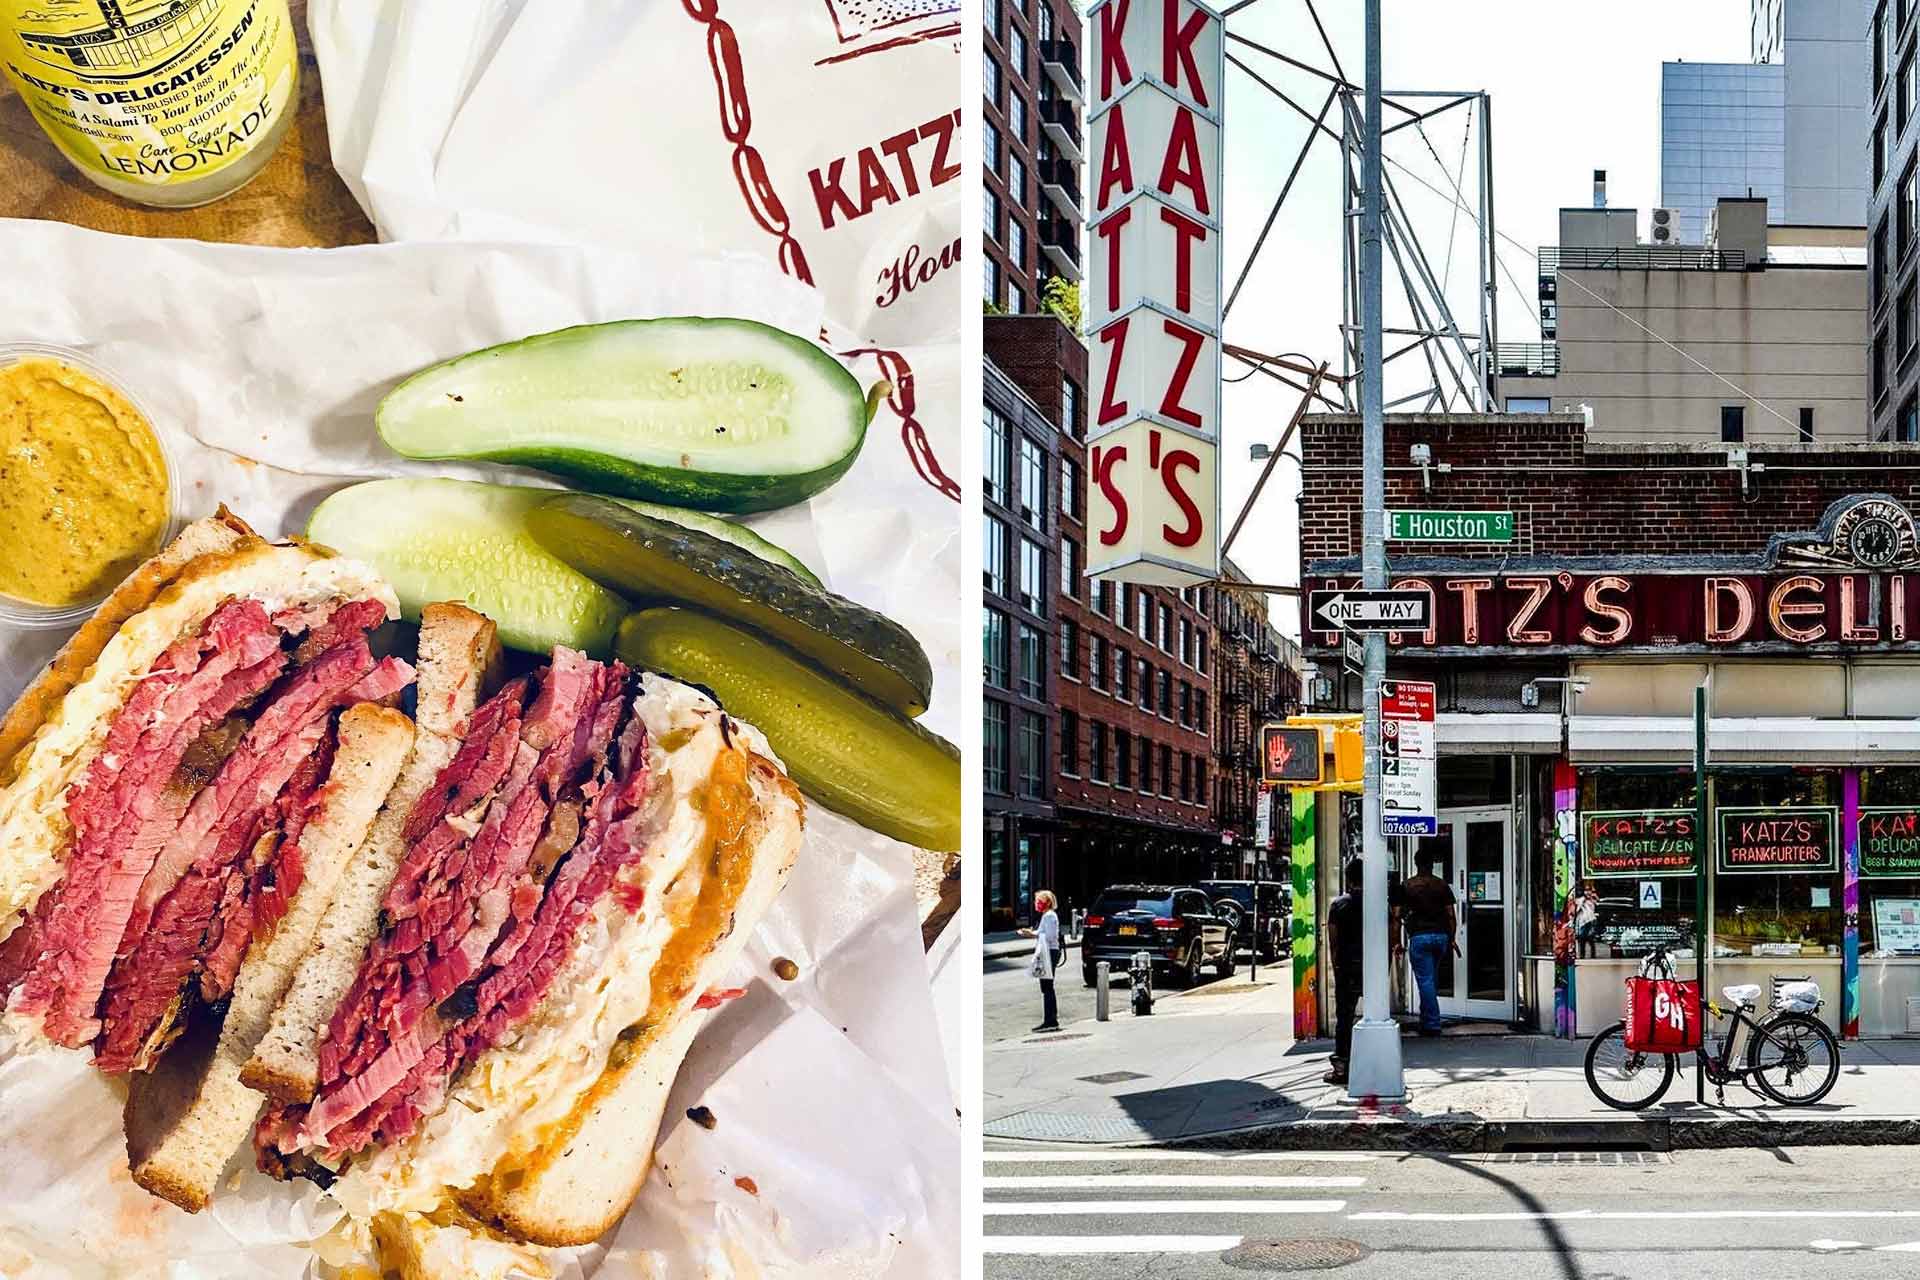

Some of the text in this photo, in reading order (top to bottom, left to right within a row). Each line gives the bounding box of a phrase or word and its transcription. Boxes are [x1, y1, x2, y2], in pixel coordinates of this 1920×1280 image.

[81, 113, 90, 122] A
[93, 114, 139, 128] Salami
[142, 113, 158, 125] To
[162, 103, 191, 119] Your
[195, 89, 217, 107] Boy
[218, 78, 229, 92] in
[122, 91, 189, 114] ESTABLISHED
[160, 90, 238, 137] 800-4HOTDOG
[101, 93, 273, 175] LEMONADE
[141, 121, 228, 159] Cane Sugar
[1092, 0, 1134, 547] KATZ'S
[1150, 0, 1209, 548] KATZ'S
[1392, 515, 1508, 538] E Houston St
[1328, 602, 1416, 619] ONE WAY
[1705, 575, 1905, 643] DELI
[1385, 759, 1396, 774] 2
[1742, 819, 1812, 844] KATZ'S
[1593, 839, 1694, 856] DELICATESSEN
[1731, 846, 1821, 863] FRANKFURTERS
[1643, 885, 1658, 901] A
